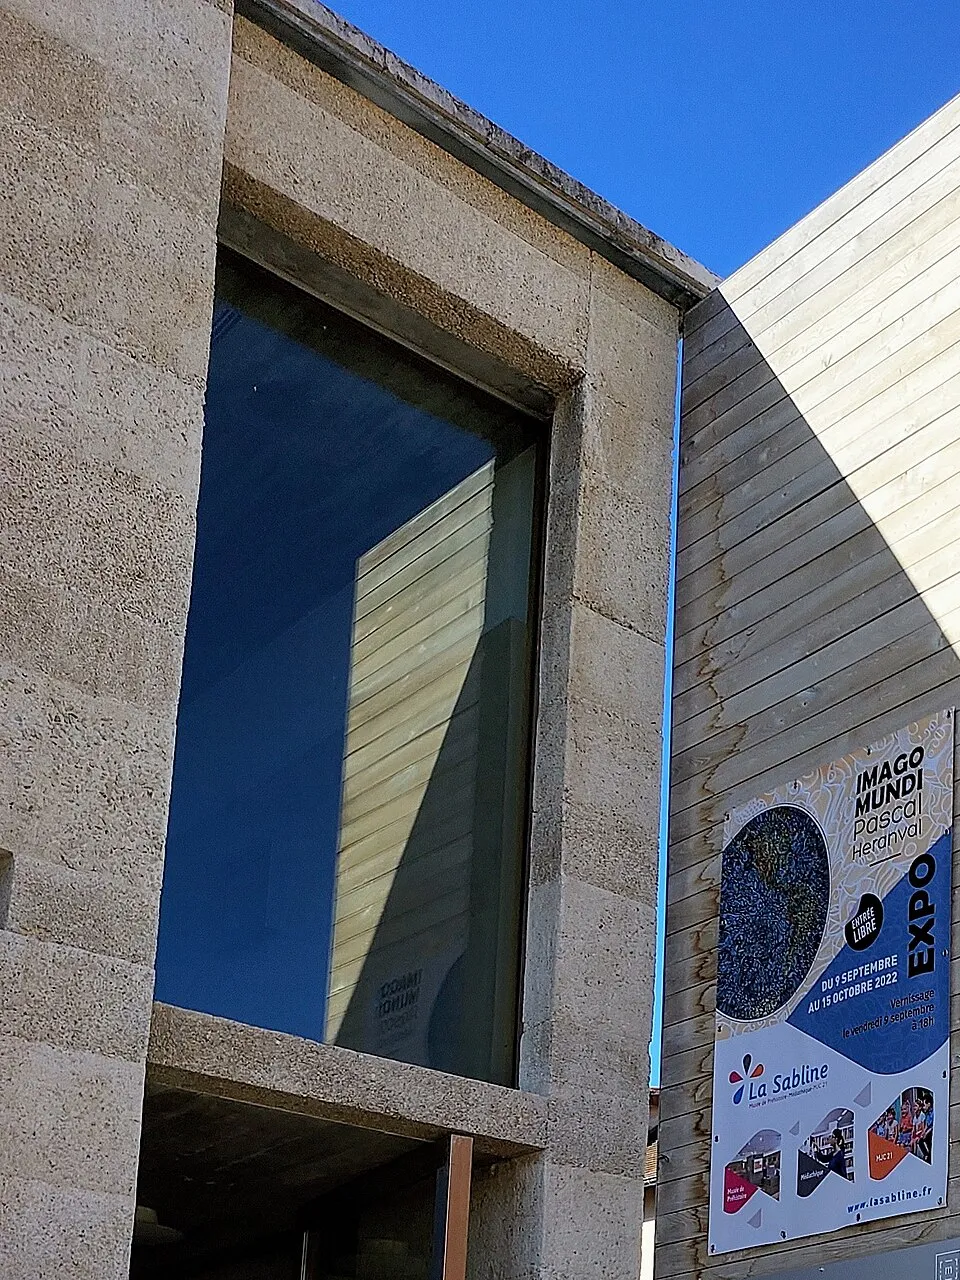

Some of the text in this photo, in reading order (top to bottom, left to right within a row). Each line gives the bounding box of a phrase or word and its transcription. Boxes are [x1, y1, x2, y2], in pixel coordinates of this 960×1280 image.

[856, 746, 924, 795] IMAGO
[855, 768, 923, 818] MUNDI
[854, 792, 921, 841] Pascal
[853, 818, 921, 860] Heranval
[851, 906, 875, 930] ENTRÉE
[852, 918, 877, 944] LIBRE
[908, 854, 936, 978] EXPO
[821, 954, 898, 993] DU 9 SEPTEMBRE
[807, 971, 898, 1014] AU 15 OCTOBRE 2022
[890, 989, 935, 1009] Vernissage
[842, 1003, 935, 1039] le vendredi 9 septembre
[920, 1017, 934, 1029] 18h
[748, 1064, 829, 1101] La Sabline
[886, 1151, 893, 1161] 21
[846, 1186, 932, 1214] www.lasabline.fr
